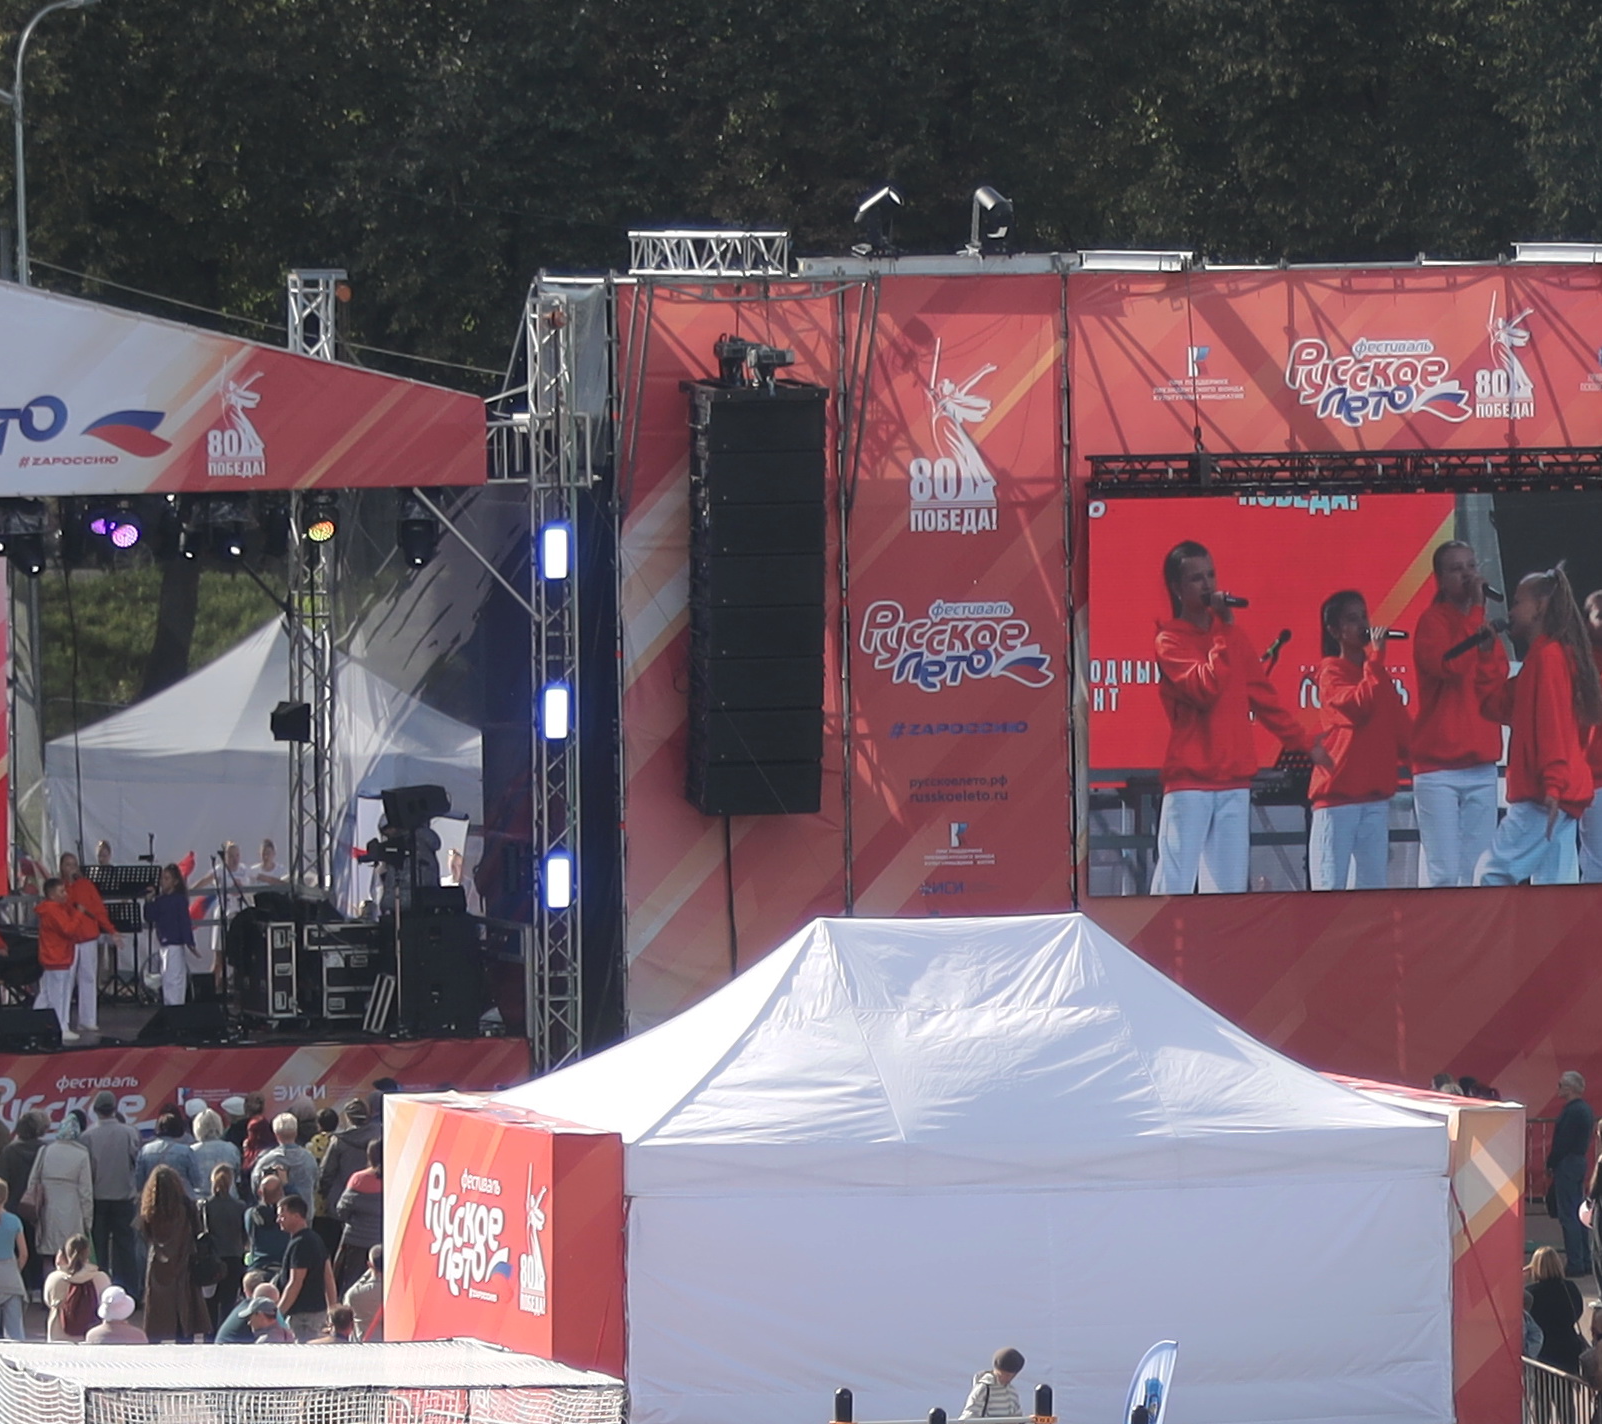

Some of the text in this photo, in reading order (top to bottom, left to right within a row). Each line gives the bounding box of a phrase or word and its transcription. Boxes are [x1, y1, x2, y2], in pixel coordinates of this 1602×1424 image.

[1353, 338, 1433, 357] фестиваль
[1286, 339, 1449, 404] Русское
[1475, 368, 1507, 398] 80
[1316, 385, 1417, 427] Лето
[1476, 402, 1535, 419] ПОБЕДА!
[208, 429, 240, 458] 80
[208, 459, 266, 478] ПОБЕДА!
[909, 457, 957, 500] 80
[910, 508, 998, 534] ПОБЕДА!
[930, 600, 1013, 620] фестиваль
[860, 600, 1030, 669] Русское
[892, 650, 996, 692] Лето
[909, 790, 1008, 804] russkoeleto.ru
[56, 1075, 139, 1094] фестиваль
[424, 1160, 505, 1255] Русское
[437, 1236, 489, 1297] Лето
